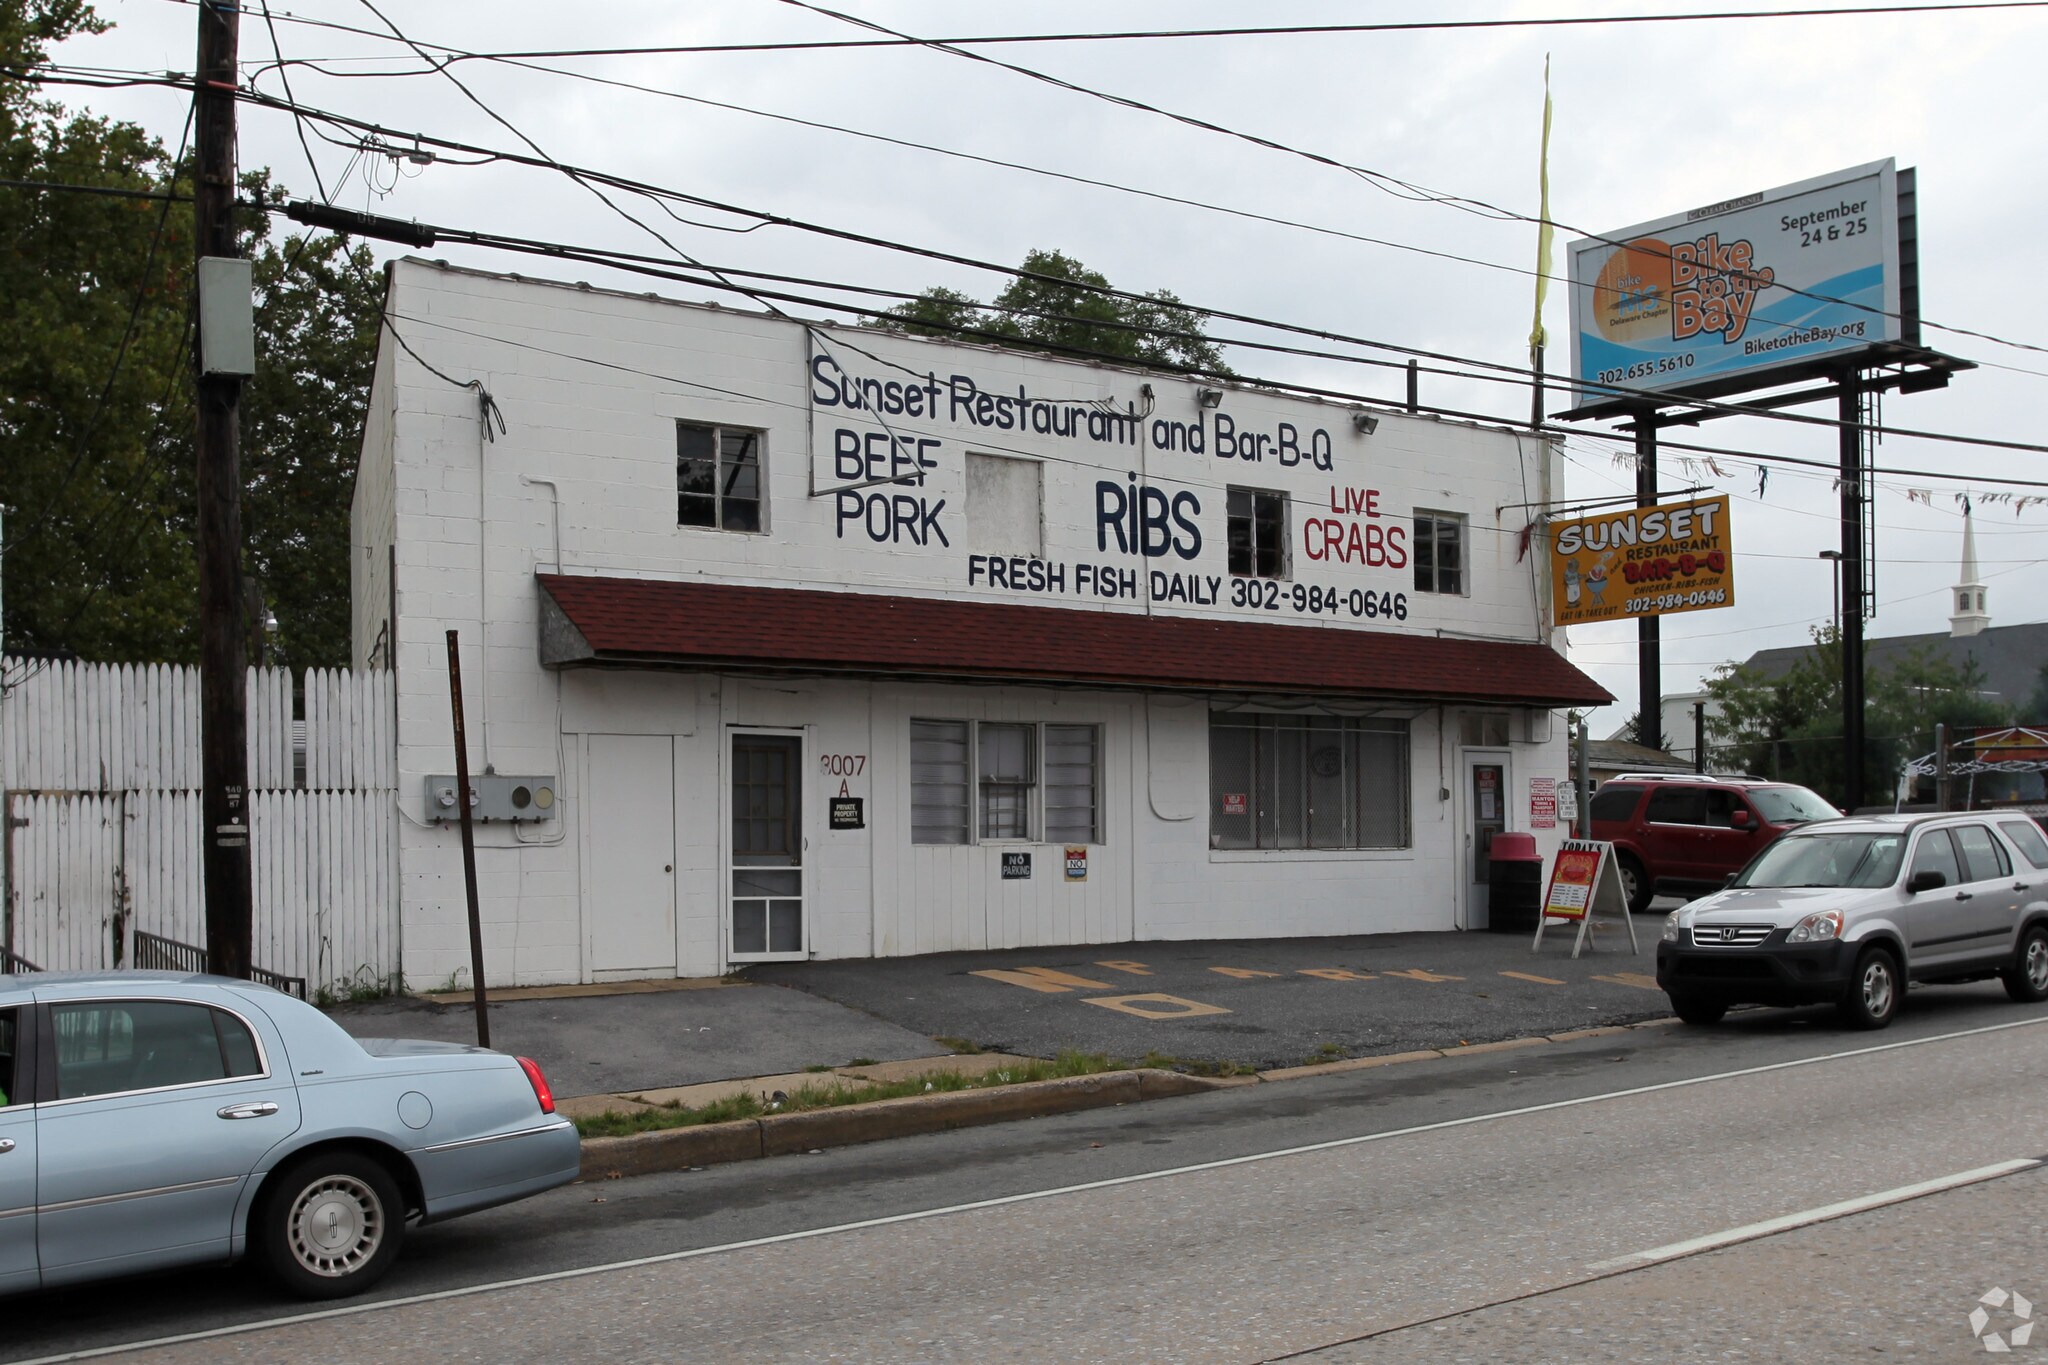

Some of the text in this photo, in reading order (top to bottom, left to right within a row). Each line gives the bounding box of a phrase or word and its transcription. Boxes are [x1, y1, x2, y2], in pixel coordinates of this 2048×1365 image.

[1781, 200, 1867, 232] September
[1801, 217, 1867, 248] 24 & 25
[1671, 232, 1753, 287] Bike
[1617, 274, 1642, 289] bike
[1697, 266, 1774, 300] to the
[1609, 308, 1669, 327] Delaware Chapter
[1672, 288, 1757, 344] Bay
[1744, 320, 1866, 355] BiketotheBay.org
[1598, 353, 1694, 384] 302.655.5610
[812, 354, 1333, 471] Sunset Restaurant and Bar-B-Q
[835, 429, 941, 487] BEEF
[1331, 485, 1381, 518] LIVE
[836, 490, 949, 548] PORK
[1556, 502, 1721, 555] SUNSET
[1304, 517, 1407, 569] CRABS
[1626, 536, 1720, 561] RESTAURANT
[1622, 550, 1726, 584] BAR-B-Q
[968, 555, 1408, 621] FRESH FISH DAILY 302-984-0646
[1625, 588, 1727, 613] 302-984-0646
[1561, 610, 1573, 621] EAT
[1603, 605, 1618, 617] OUT
[820, 754, 866, 776] 3007
[838, 778, 850, 798] A
[1009, 855, 1025, 865] NO
[1562, 841, 1603, 853] TODAY'S
[1003, 865, 1030, 876] PARKING
[1070, 860, 1083, 868] NO
